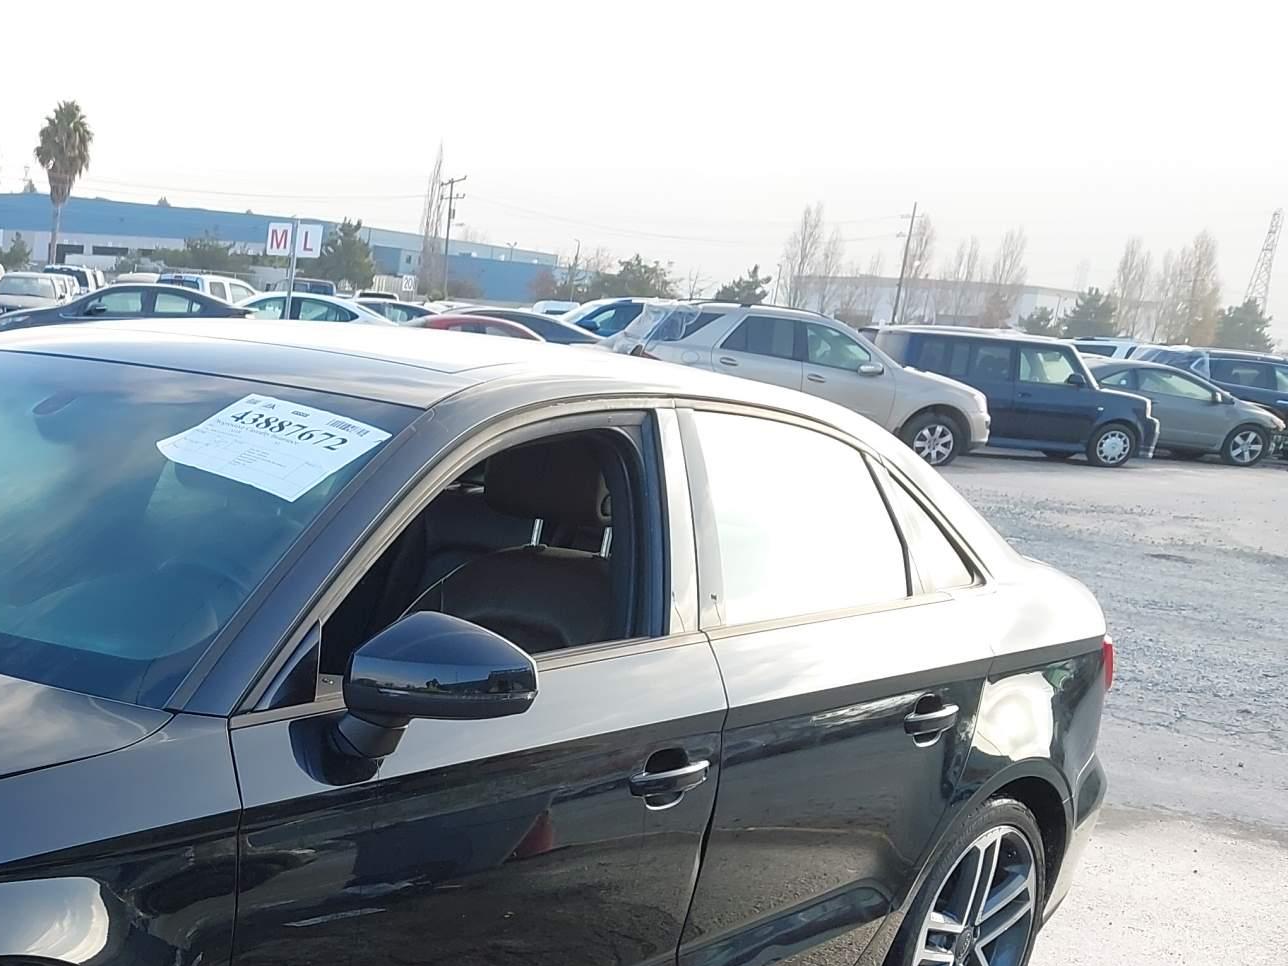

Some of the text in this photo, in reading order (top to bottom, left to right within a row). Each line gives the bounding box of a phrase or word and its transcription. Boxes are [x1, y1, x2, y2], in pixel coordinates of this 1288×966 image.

[270, 229, 289, 250] M
[303, 231, 314, 252] L
[230, 411, 349, 451] 43887672
